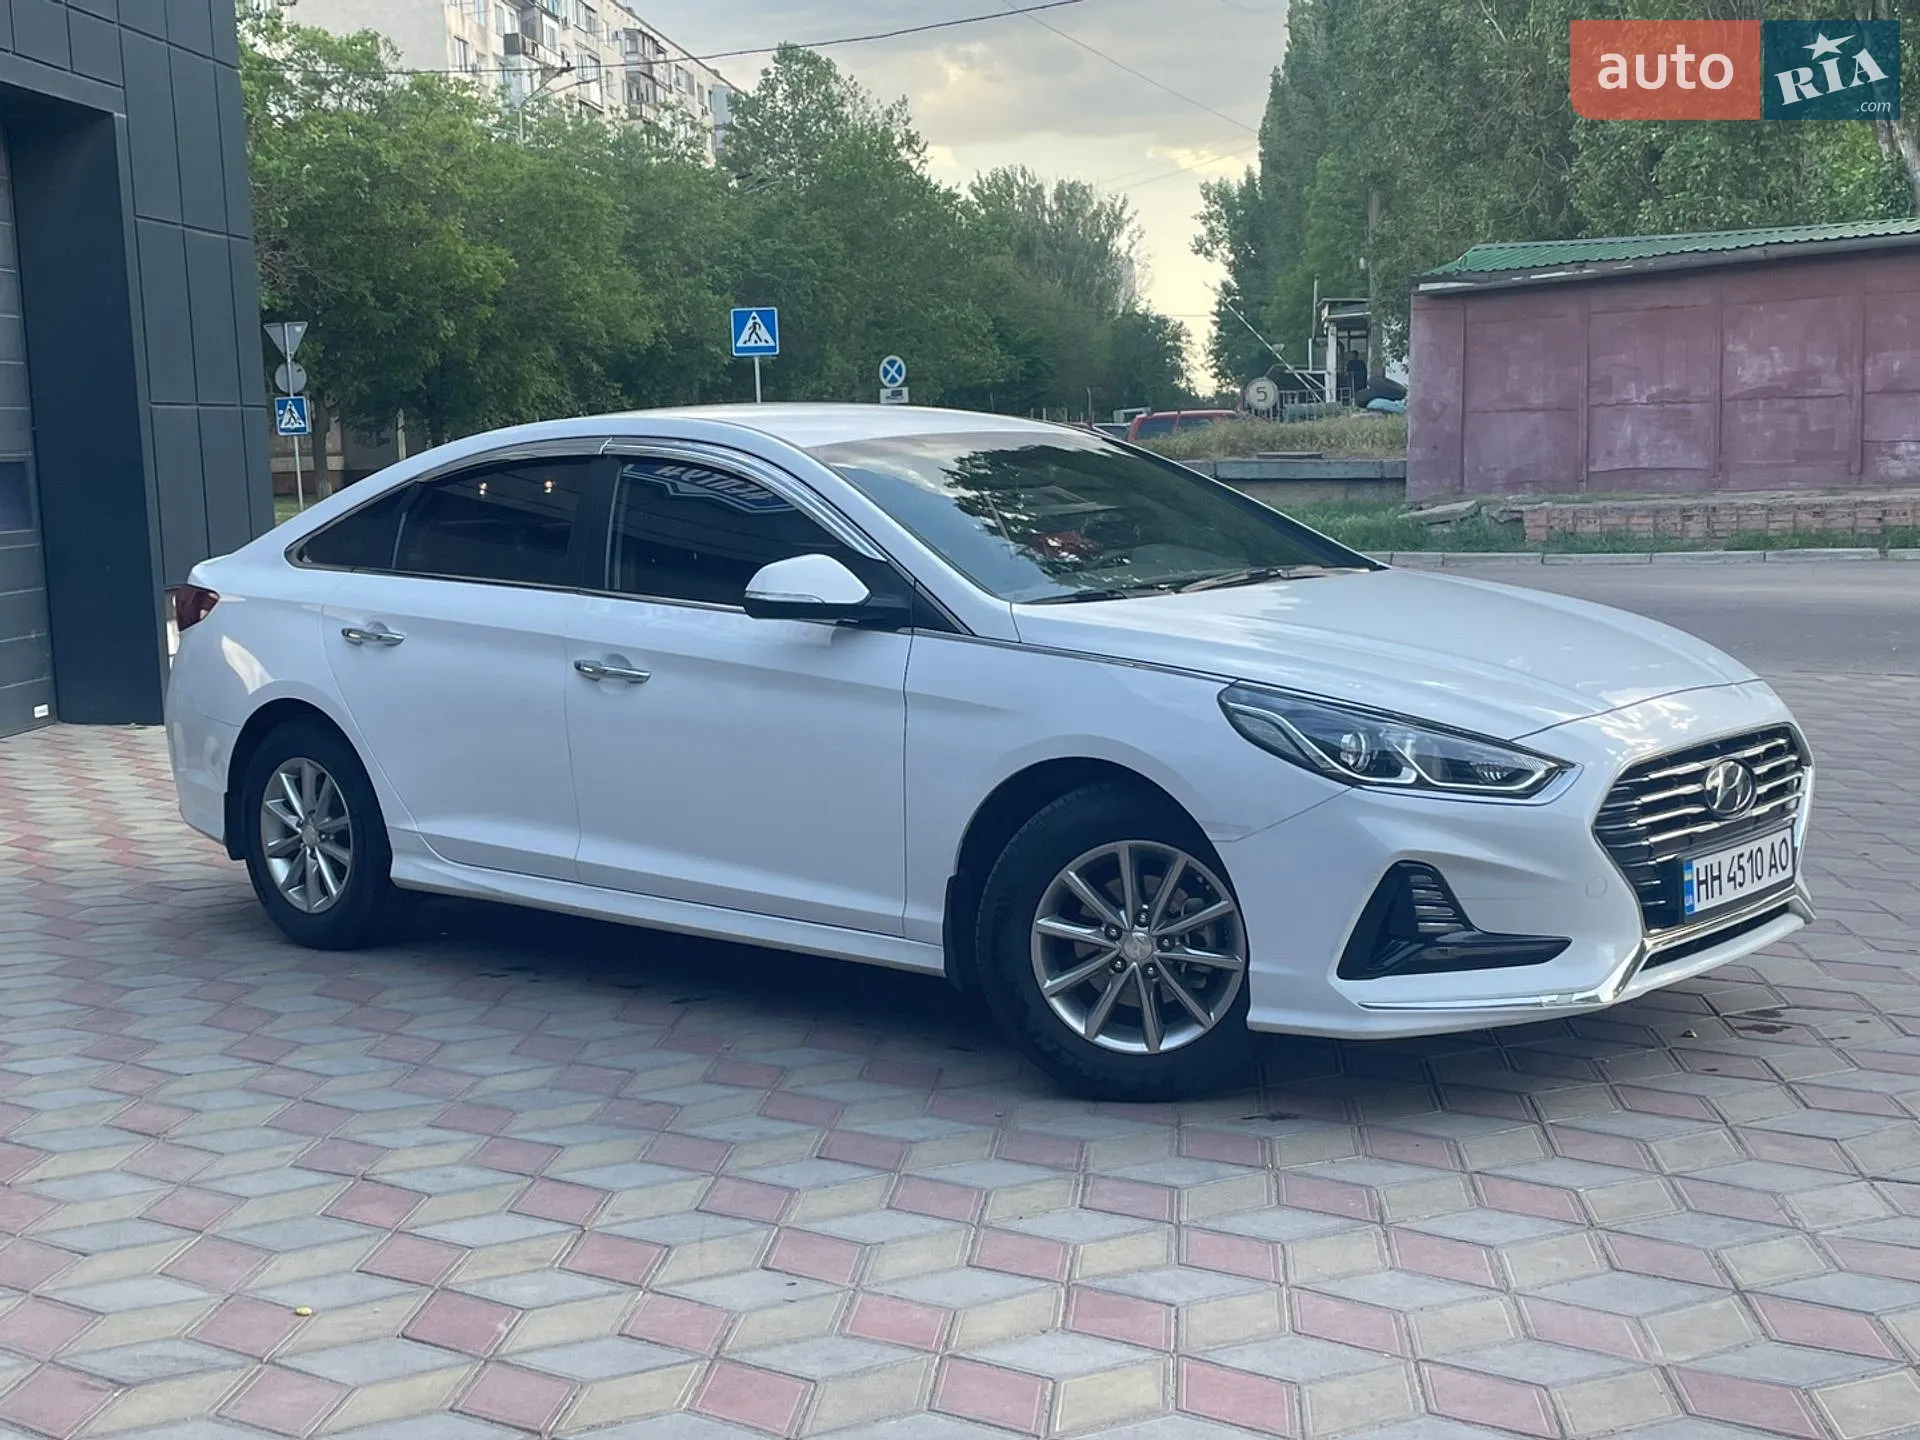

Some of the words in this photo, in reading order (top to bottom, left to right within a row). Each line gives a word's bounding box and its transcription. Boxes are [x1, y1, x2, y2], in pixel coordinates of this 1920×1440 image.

[1256, 386, 1268, 402] 5
[1696, 861, 1723, 903] HH
[1727, 847, 1764, 890] 4510
[1768, 837, 1789, 877] AO
